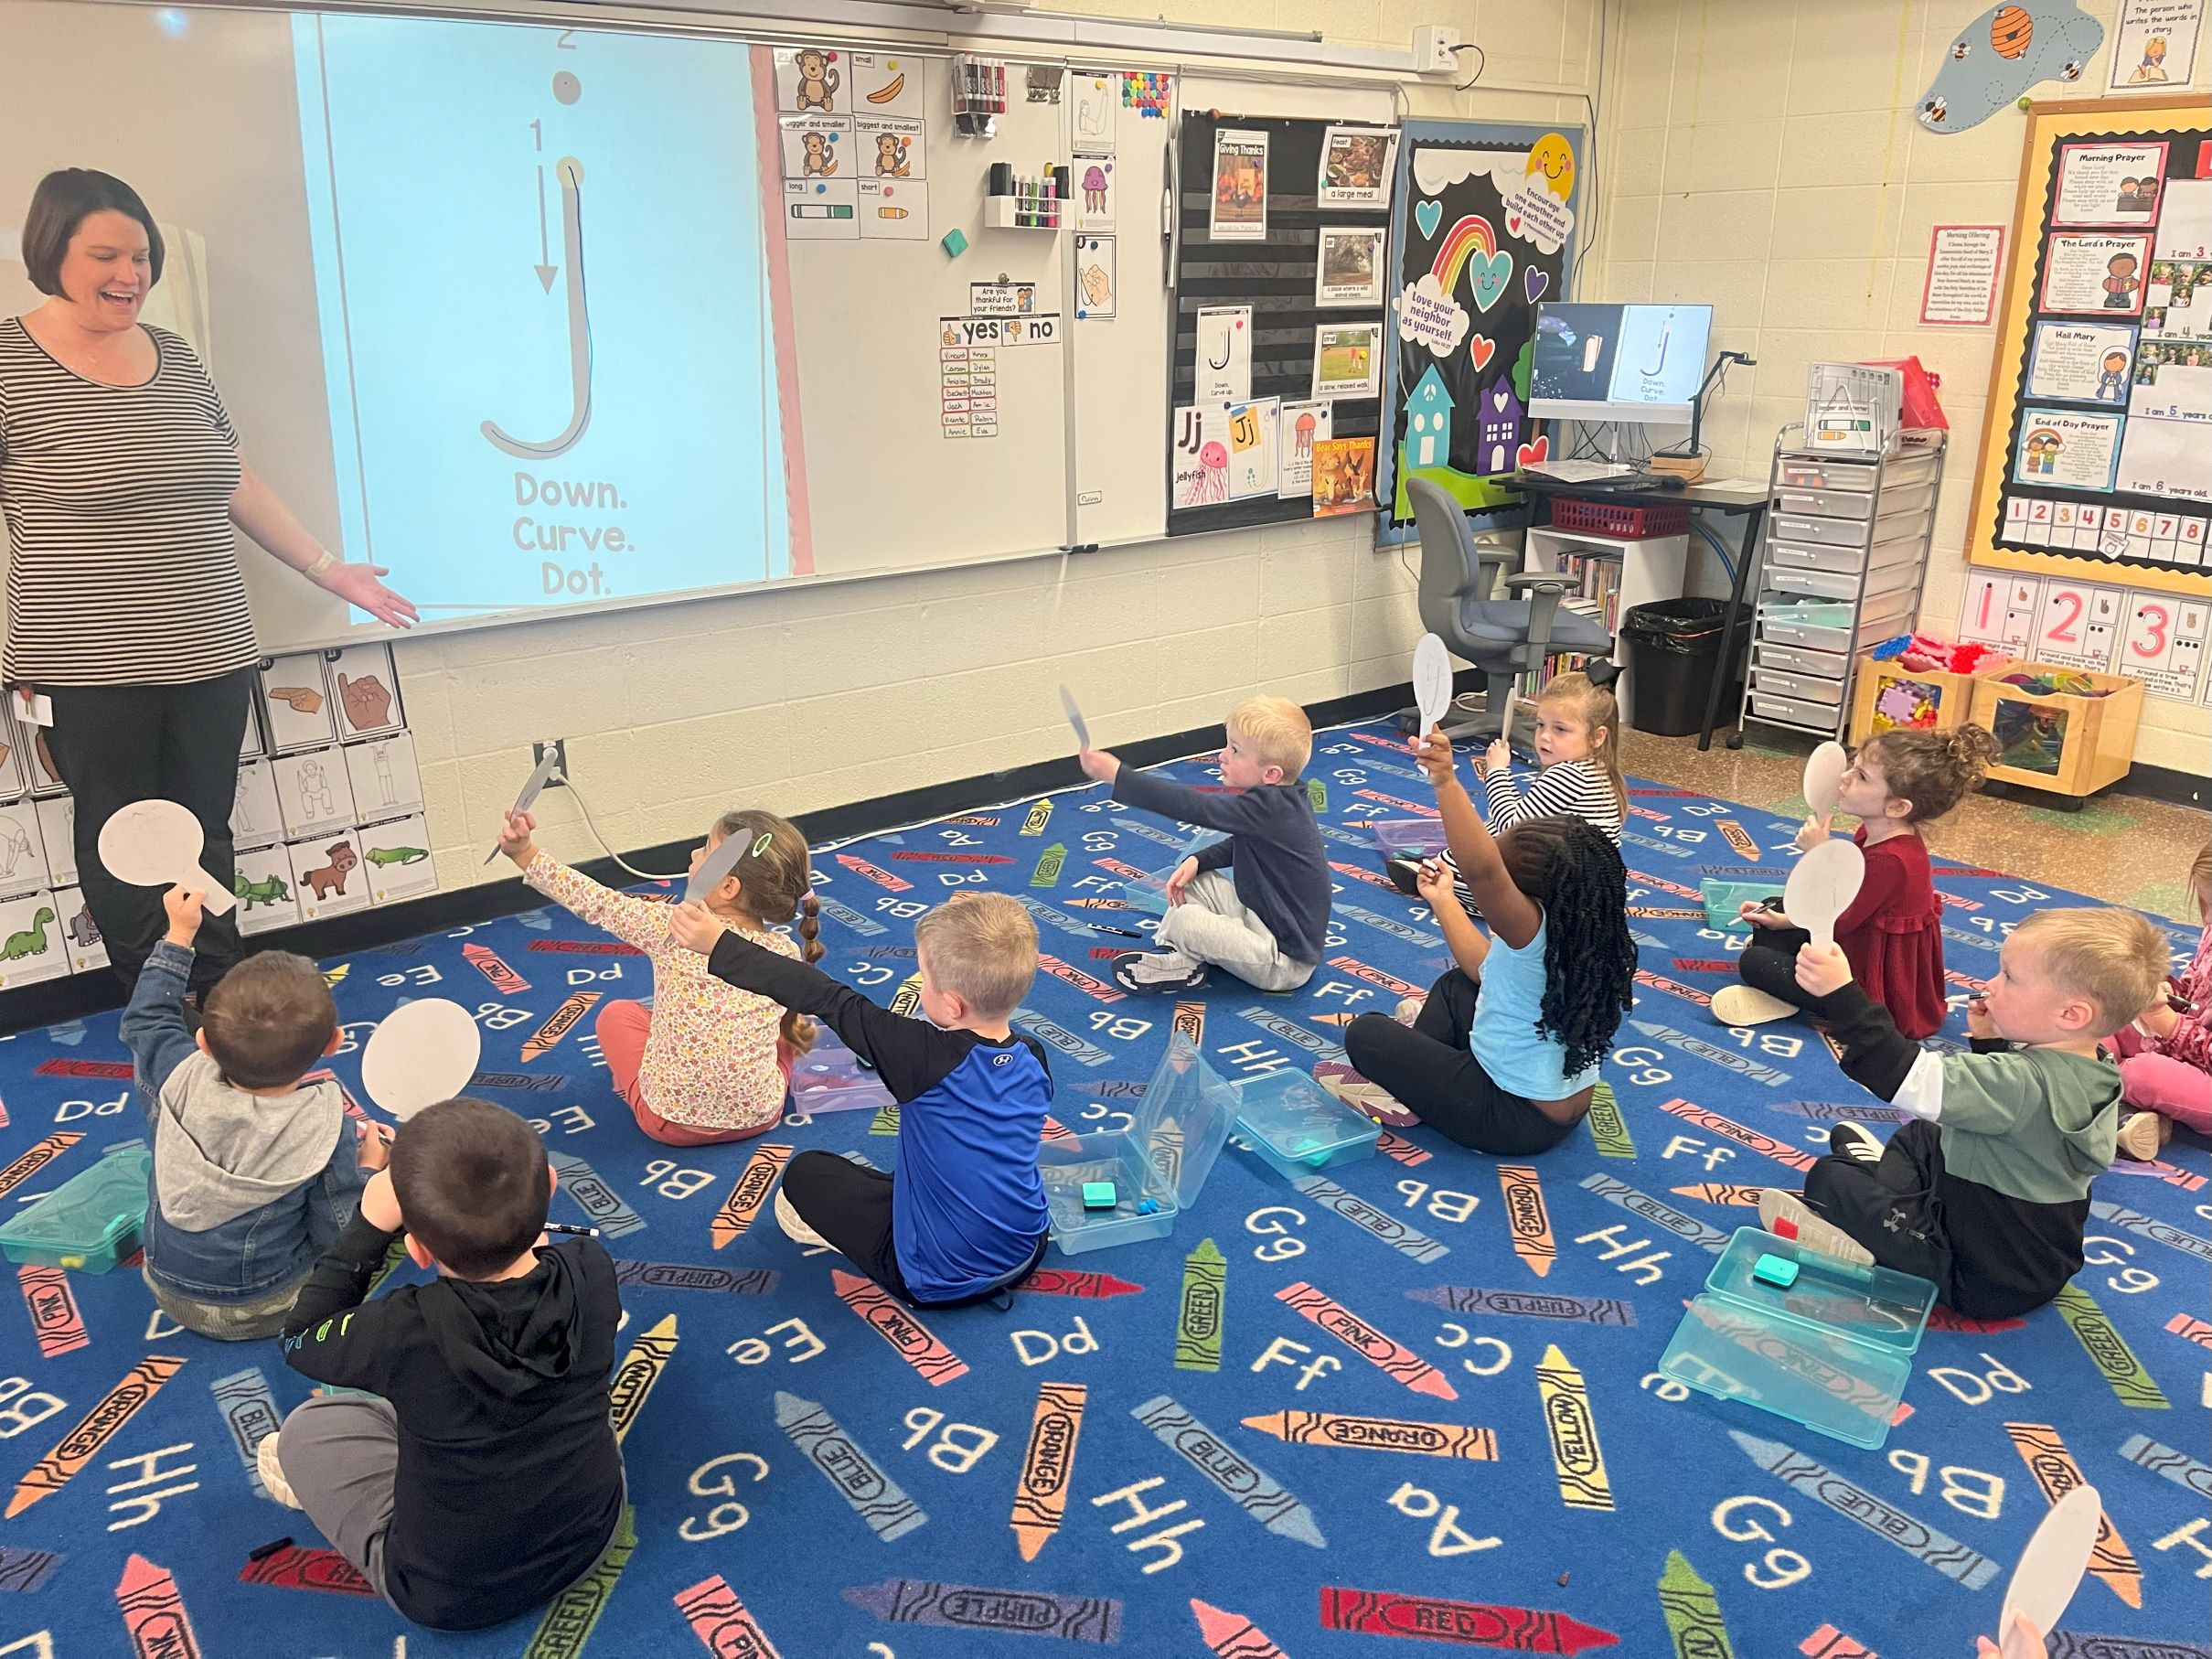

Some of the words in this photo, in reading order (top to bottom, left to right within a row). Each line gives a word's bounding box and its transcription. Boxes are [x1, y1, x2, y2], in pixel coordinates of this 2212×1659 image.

[2150, 5, 2175, 16] person
[857, 121, 880, 130] biggest
[1220, 144, 1238, 155] Giving
[1240, 145, 1263, 155] Thanks
[2116, 154, 2145, 163] Prayer
[789, 182, 802, 191] long
[1338, 190, 1355, 199] large
[1527, 187, 1559, 212] Encourage
[1506, 198, 1523, 213] build
[1523, 210, 1538, 223] each
[1539, 219, 1555, 232] other
[1556, 230, 1565, 240] up.
[1515, 194, 1526, 205] one
[1528, 201, 1553, 219] another
[1554, 218, 1565, 228] and
[2106, 241, 2136, 250] Prayer
[2196, 247, 2204, 257] 3
[1410, 306, 1450, 326] neighbor
[1412, 292, 1432, 307] Love
[1434, 302, 1455, 316] your
[963, 322, 998, 345] yes
[1030, 322, 1053, 338] no
[1402, 316, 1413, 326] as
[1414, 319, 1452, 342] yourself.
[2056, 331, 2071, 339] Hail
[2073, 332, 2095, 341] Mary
[1640, 386, 1665, 395] Curve.
[1642, 378, 1665, 387] Down.
[1178, 412, 1202, 454] Jj
[1235, 416, 1255, 445] Jj
[2053, 419, 2061, 427] of
[2063, 419, 2078, 429] Day
[2081, 423, 2110, 432] Prayer
[1316, 444, 1331, 453] Bear
[1332, 443, 1347, 451] Says
[1349, 441, 1372, 449] Thanks
[514, 472, 628, 509] Down.
[1176, 470, 1206, 483] jellyfish
[513, 518, 635, 552] Curve.
[2014, 503, 2019, 517] 1
[2035, 505, 2046, 519] 2
[2059, 508, 2069, 522] 3
[2083, 510, 2093, 524] 4
[2110, 513, 2121, 528] 5
[2136, 518, 2148, 532] 6
[2161, 519, 2172, 535] 7
[2187, 524, 2197, 538] 8
[542, 562, 612, 595] Dot.
[2046, 591, 2082, 643] 2
[2131, 605, 2168, 658] 3
[2039, 651, 2057, 659] Around
[1320, 743, 1364, 755] Ee
[1332, 768, 1367, 786] Gg
[1080, 799, 1128, 813] Ee
[1343, 803, 1389, 818] Ff
[1682, 802, 1732, 817] Dd
[938, 830, 984, 847] Aa
[1082, 830, 1119, 851] Gg
[1653, 826, 1707, 843] Bb
[937, 869, 988, 886] Dd
[875, 897, 929, 918] Bb
[1990, 885, 2051, 904] Dd
[376, 964, 443, 987] Ee
[566, 963, 623, 986] Dd
[848, 961, 893, 985] Cc
[1369, 972, 1395, 987] PINK
[1312, 981, 1373, 1006] Ff
[474, 1002, 534, 1030] Bb
[1088, 1011, 1153, 1041] Bb
[1280, 1021, 1313, 1044] BLUE
[1728, 1027, 1804, 1057] Bb
[1612, 1046, 1672, 1086] Gg
[1693, 1044, 1742, 1065] BLUE
[54, 1094, 130, 1122] Dd
[1714, 1121, 1766, 1145] PINK
[1662, 1135, 1736, 1171] Ff
[578, 1181, 611, 1208] BLUE
[639, 1160, 717, 1200] Bb
[732, 1162, 775, 1209] ORANGE
[1395, 1179, 1480, 1223] Bb
[1513, 1186, 1541, 1235] ORANGE
[1638, 1201, 1693, 1230] BLUE
[1245, 1206, 1306, 1262] Gg
[1574, 1225, 1672, 1286] Hh
[2083, 1236, 2160, 1293] Gg
[1189, 1288, 1218, 1333] GREEN
[726, 1317, 828, 1365] Ee
[883, 1316, 923, 1350] PINK
[1010, 1315, 1100, 1366] Dd
[1332, 1314, 1380, 1350] PINK
[1435, 1322, 1512, 1375] Cc
[2085, 1326, 2130, 1372] GREEN
[1251, 1336, 1341, 1391] Ff
[1928, 1353, 2033, 1406] Dd
[63, 1389, 144, 1457] ORANGE
[1333, 1421, 1439, 1446] ORANGE
[1556, 1398, 1587, 1466] YELLOW
[901, 1407, 999, 1473] Bb
[1030, 1418, 1067, 1490] ORANGE
[824, 1440, 871, 1489] BLUE
[1190, 1436, 1245, 1487] BLUE
[106, 1442, 199, 1532] Hh
[679, 1452, 769, 1543] Gg
[1888, 1450, 2005, 1520] Bb
[1092, 1476, 1204, 1575] Hh
[1385, 1482, 1502, 1556] Aa
[1841, 1490, 1912, 1534] BLUE
[1712, 1495, 1811, 1589] Gg
[952, 1593, 1053, 1625] PURPLE
[1415, 1607, 1477, 1637] RED
